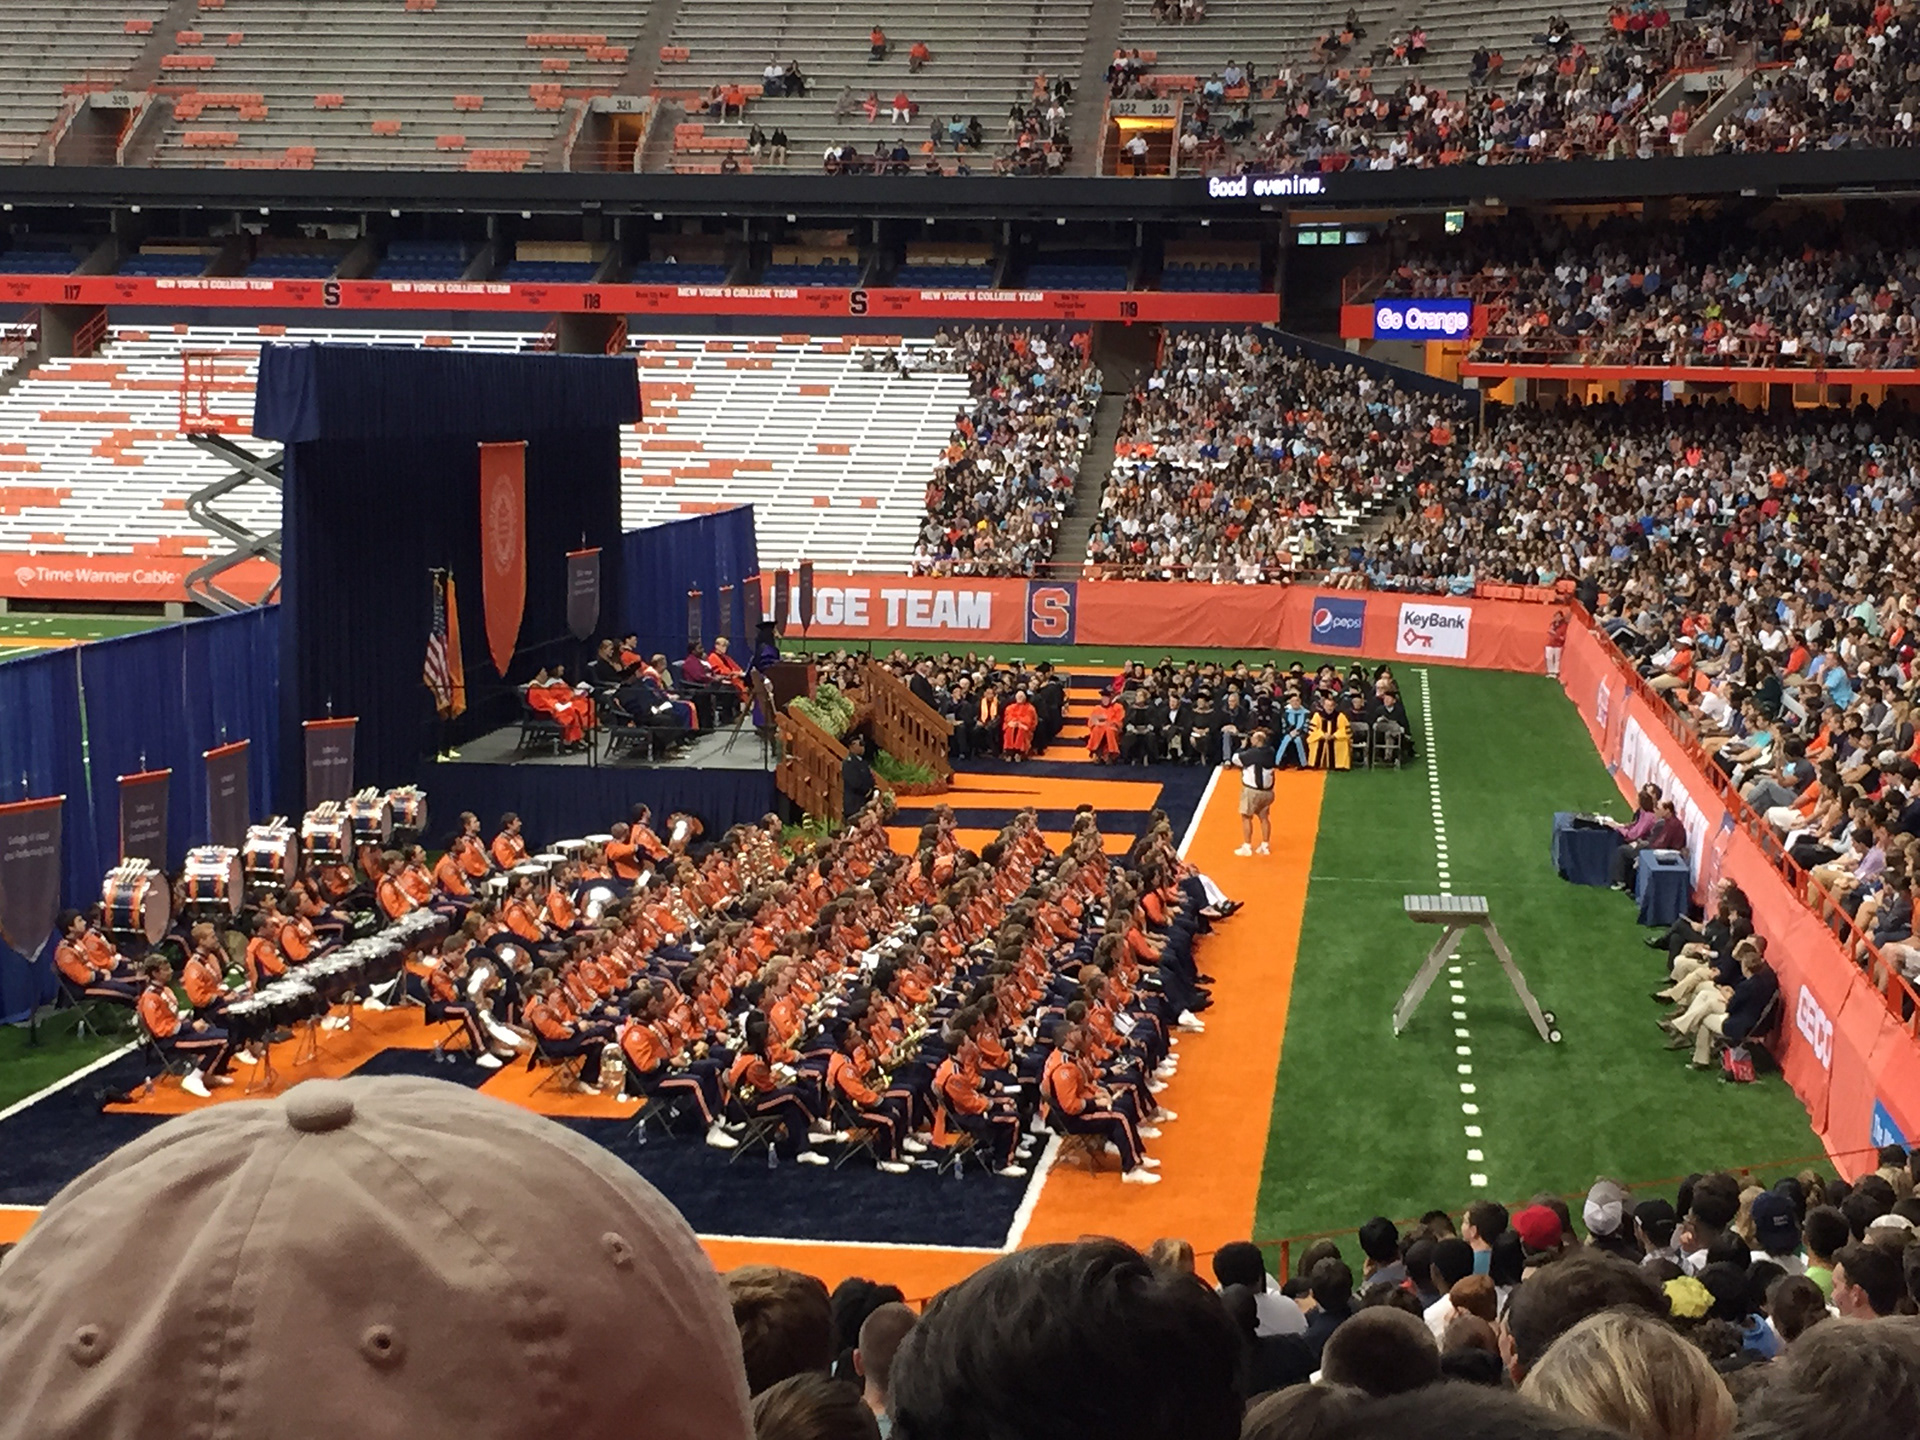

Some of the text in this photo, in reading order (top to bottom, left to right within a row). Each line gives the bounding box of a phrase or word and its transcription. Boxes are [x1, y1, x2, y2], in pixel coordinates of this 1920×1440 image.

[616, 100, 632, 110] 321
[1119, 103, 1137, 114] 322
[1209, 175, 1247, 197] Good
[64, 284, 82, 300] 117
[156, 279, 175, 288] NEW
[250, 280, 274, 290] TEAM
[392, 283, 411, 292] NEW
[487, 284, 511, 294] TEAM
[324, 280, 342, 308] S
[583, 293, 601, 309] 118
[678, 287, 697, 297] NEW
[773, 288, 798, 299] TEAM
[921, 291, 940, 300] NEW
[1019, 292, 1043, 302] TEAM
[850, 289, 868, 316] S
[1119, 301, 1138, 317] 119
[1377, 308, 1468, 334] Go Orange
[35, 567, 175, 584] Time Warner Cable
[880, 590, 991, 629] TEAM
[1031, 586, 1070, 638] S
[1333, 617, 1361, 629] pepsi
[1404, 611, 1465, 629] KeyBank
